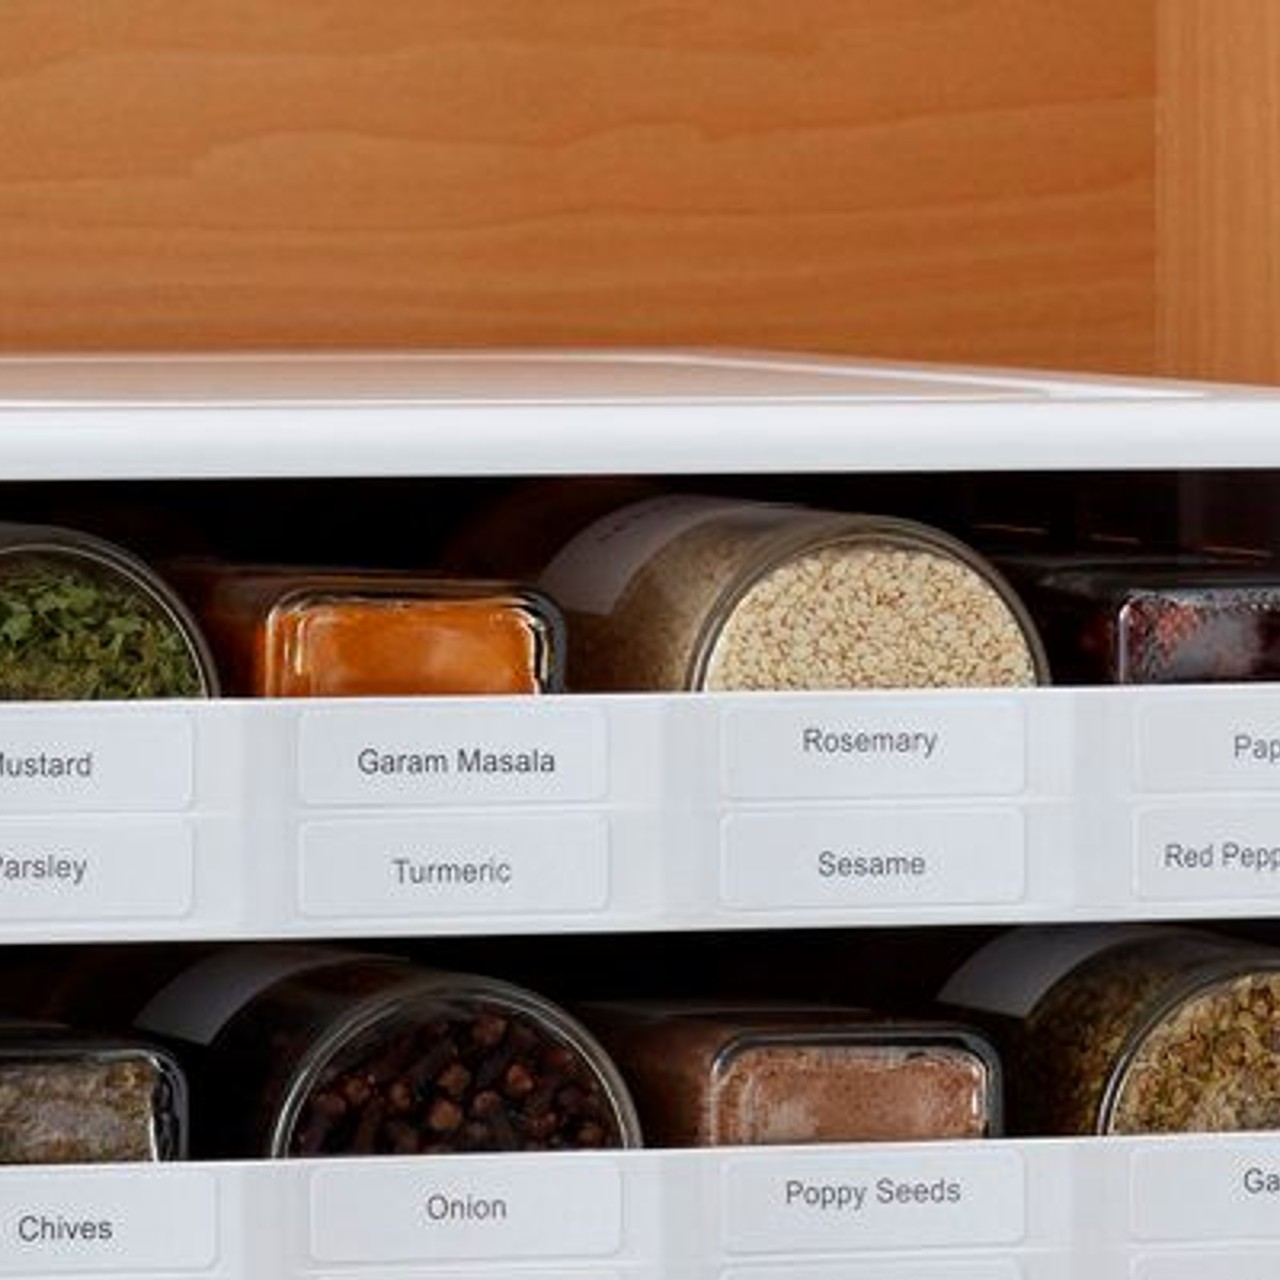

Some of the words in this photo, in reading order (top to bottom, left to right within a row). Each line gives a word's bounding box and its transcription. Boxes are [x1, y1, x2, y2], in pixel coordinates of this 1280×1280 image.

[802, 727, 939, 760] Rosemary
[356, 747, 449, 776] Garam
[456, 747, 556, 774] Masala
[817, 849, 927, 879] Sesame
[1163, 842, 1215, 869] Red
[392, 856, 511, 886] Turmeric
[425, 1193, 508, 1222] Onion
[785, 1179, 869, 1212] Poppy
[875, 1176, 962, 1205] Seeds
[17, 1214, 114, 1243] Chives
